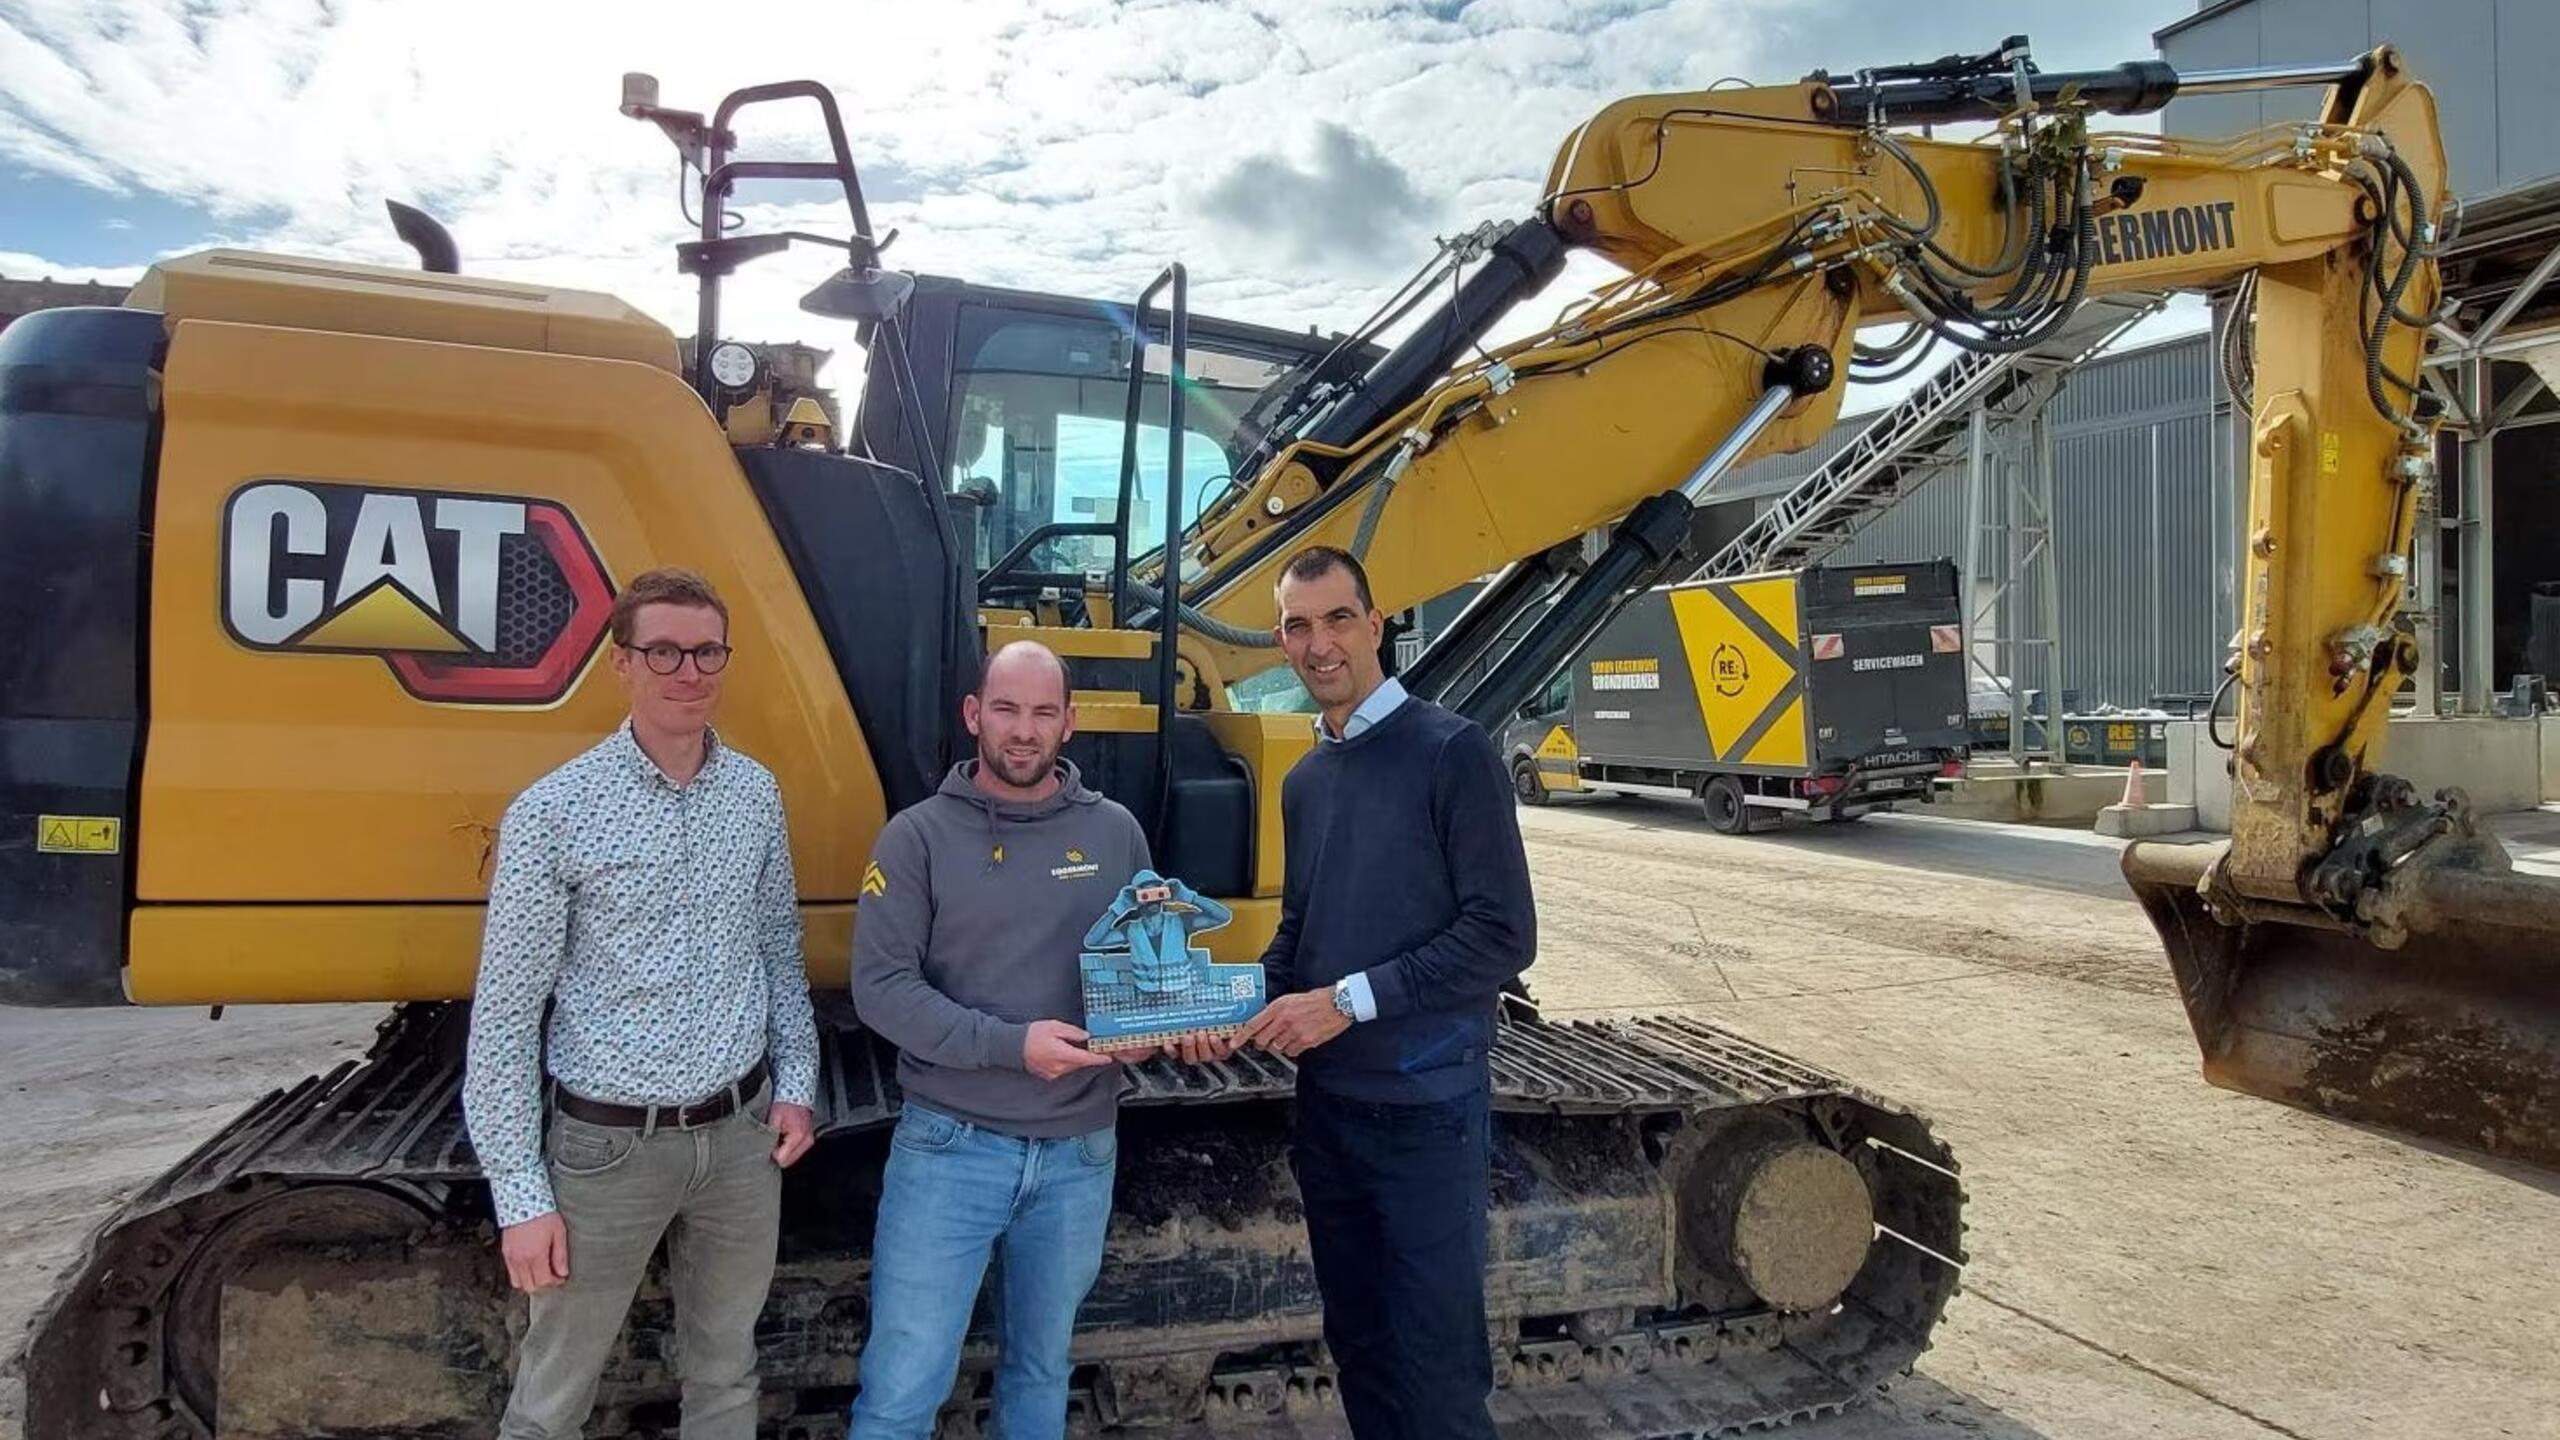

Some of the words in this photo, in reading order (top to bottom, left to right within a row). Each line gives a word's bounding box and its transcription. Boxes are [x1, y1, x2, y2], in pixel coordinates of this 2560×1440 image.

[229, 484, 526, 653] CAT
[1852, 654, 1924, 672] SERVICEWAGEN
[1865, 750, 1920, 768] HITACHI
